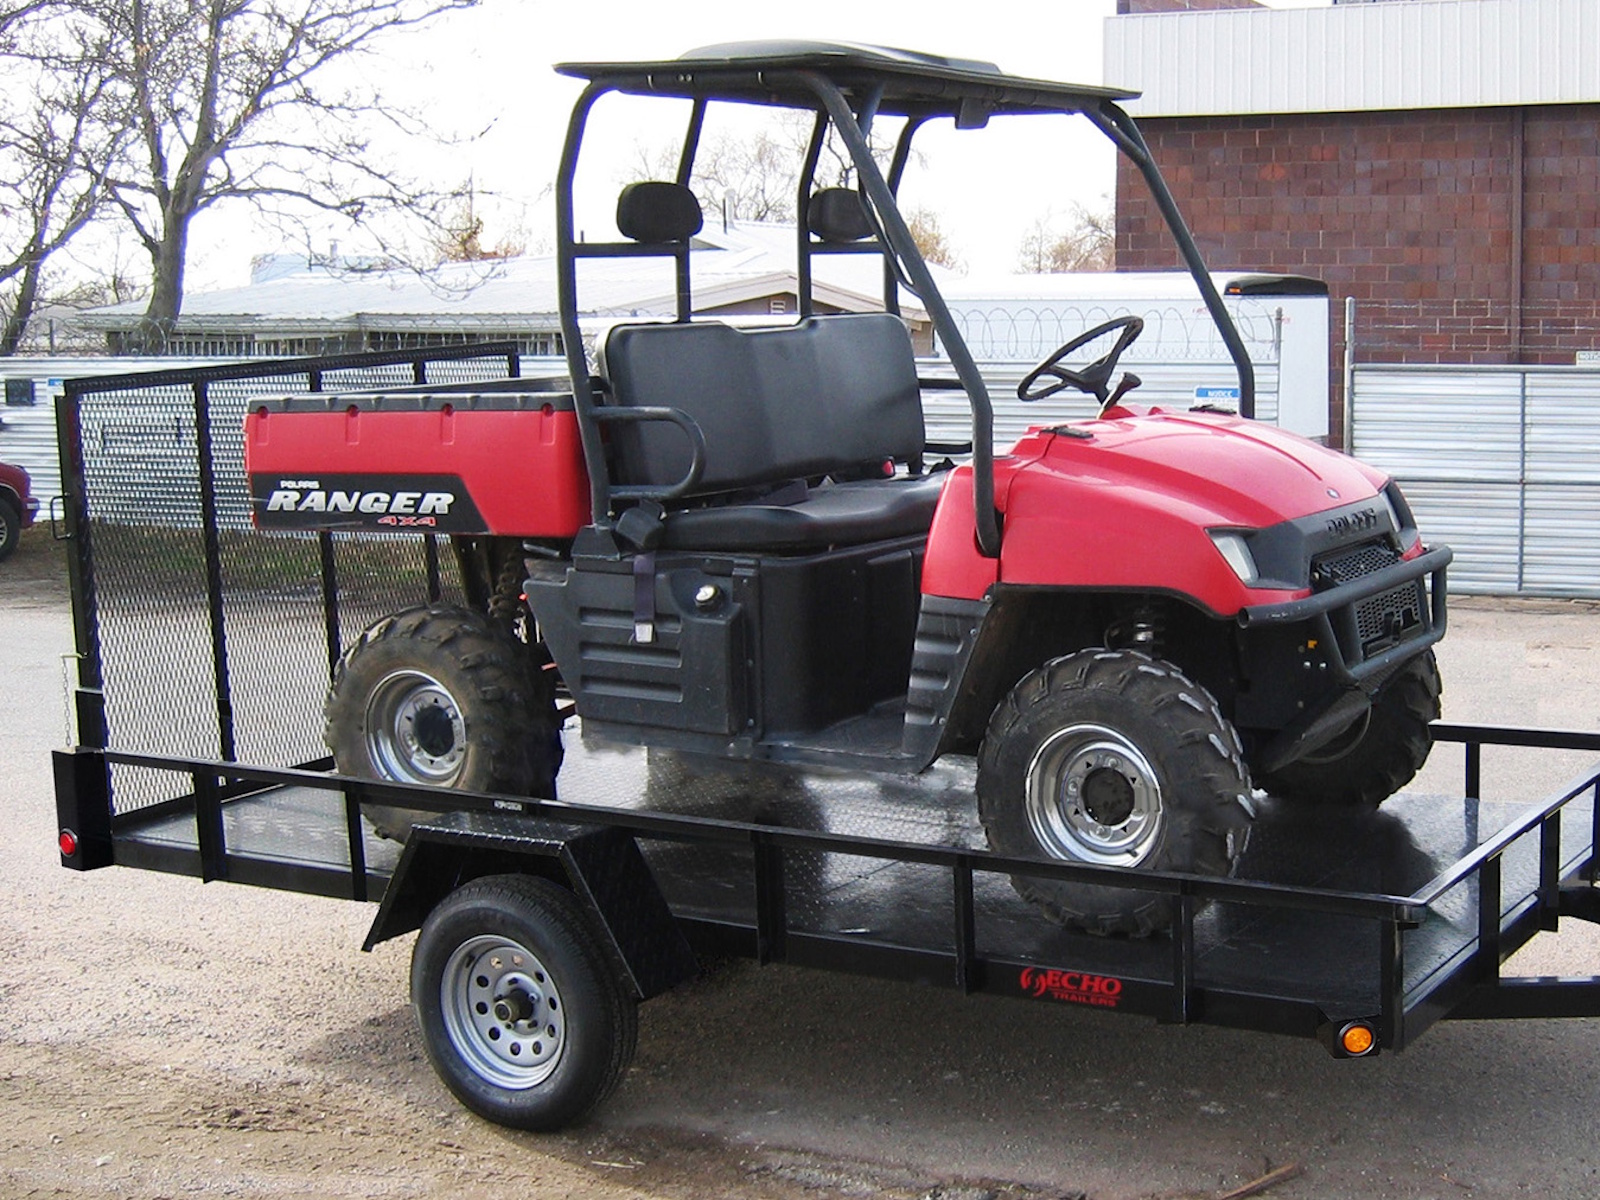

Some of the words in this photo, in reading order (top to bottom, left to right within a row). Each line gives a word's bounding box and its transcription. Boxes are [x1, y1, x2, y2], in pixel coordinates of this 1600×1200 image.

[280, 480, 319, 489] POLARIS
[267, 491, 454, 514] RANGER
[1045, 969, 1122, 995] ECHO
[1052, 991, 1117, 1007] TRAILERS
